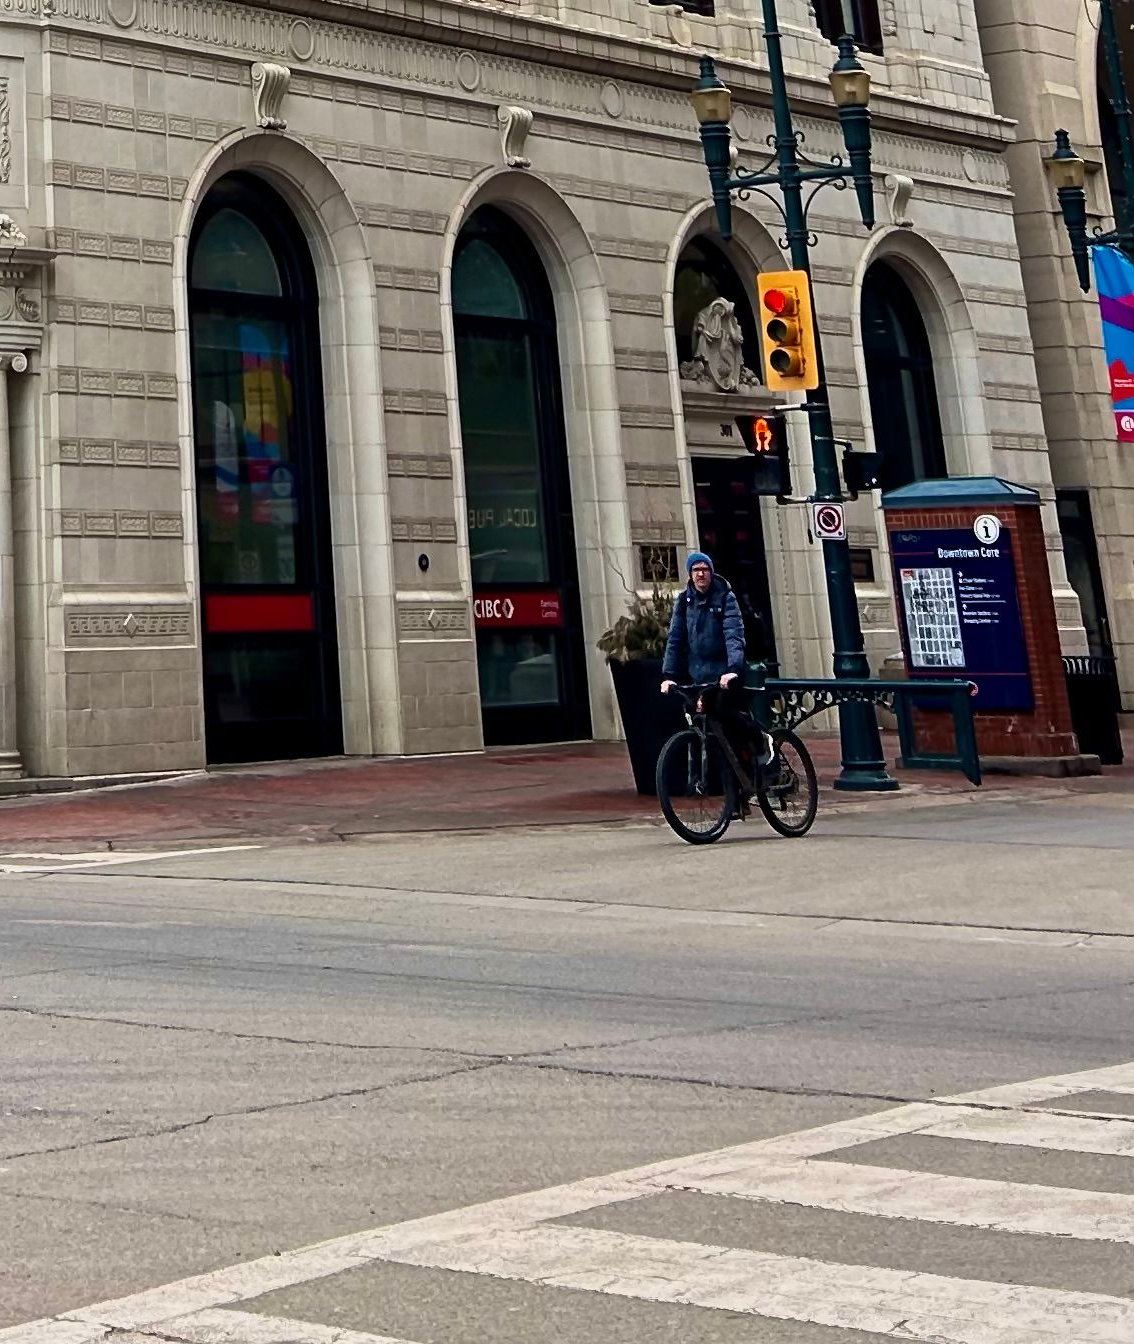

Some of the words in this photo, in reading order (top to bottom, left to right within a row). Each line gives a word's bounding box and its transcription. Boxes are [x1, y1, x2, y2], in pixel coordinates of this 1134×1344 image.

[937, 547, 980, 559] Downtown
[980, 546, 1000, 558] Core
[473, 599, 502, 619] CIBC
